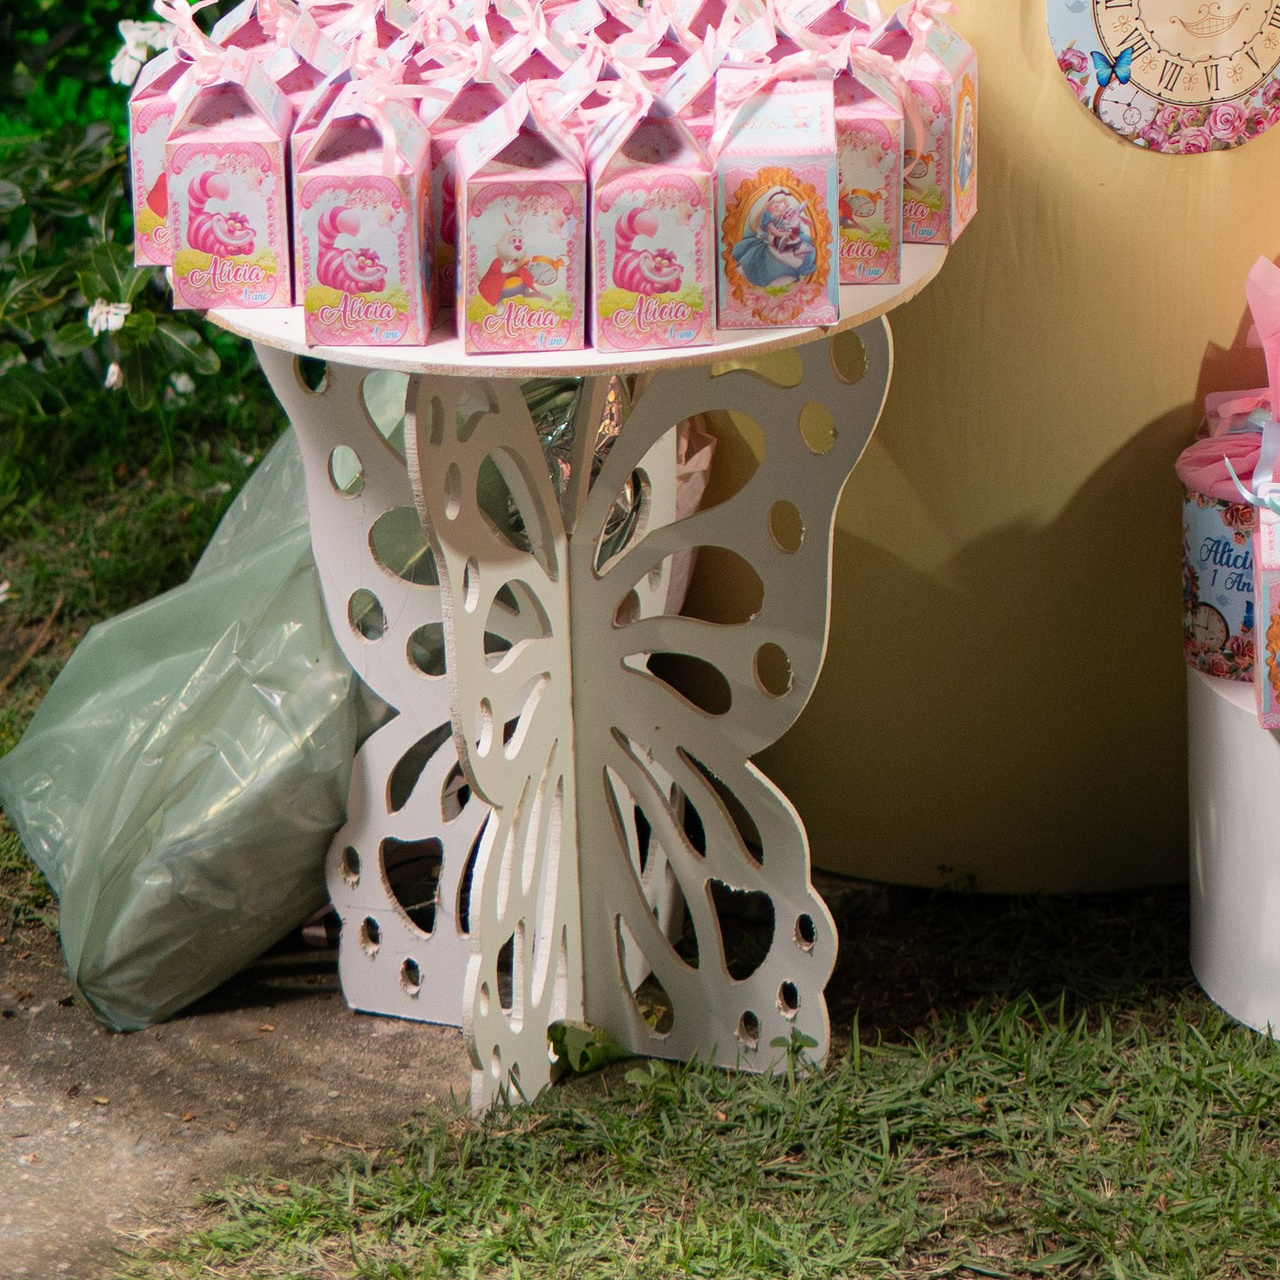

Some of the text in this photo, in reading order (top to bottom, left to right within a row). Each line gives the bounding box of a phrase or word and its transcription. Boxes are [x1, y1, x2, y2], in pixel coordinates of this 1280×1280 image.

[1158, 59, 1184, 92] VII
[1204, 64, 1221, 91] VI
[189, 256, 265, 291] Alícia
[318, 292, 396, 329] Alícia
[483, 300, 559, 338] Alícia
[612, 294, 692, 332] Alícia
